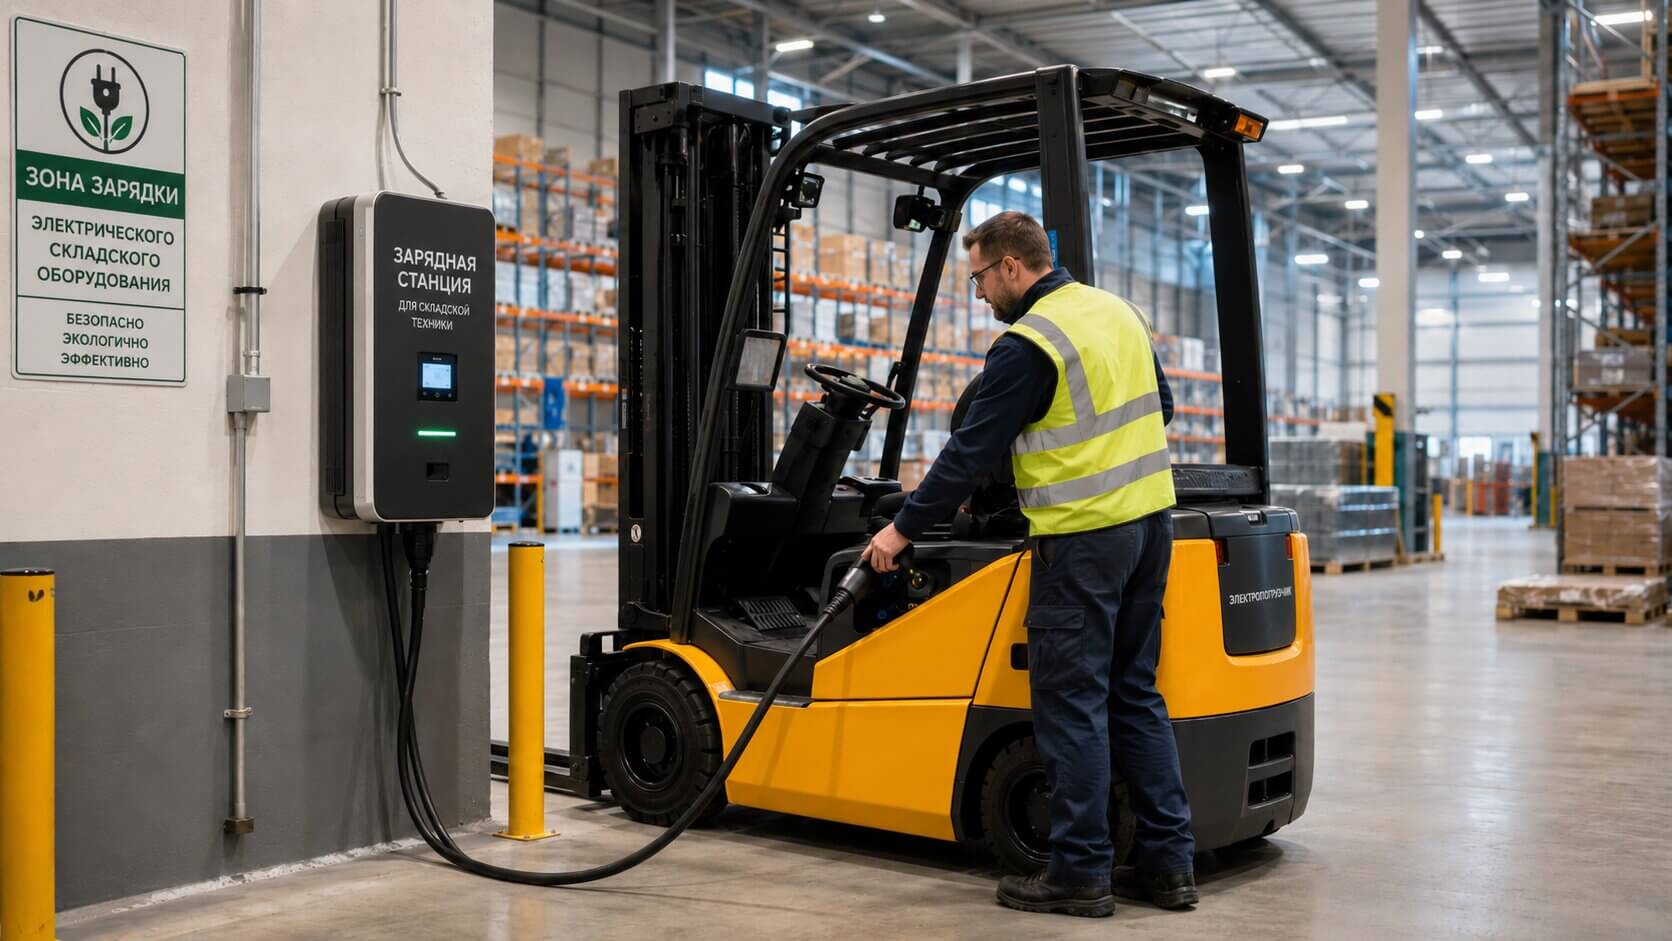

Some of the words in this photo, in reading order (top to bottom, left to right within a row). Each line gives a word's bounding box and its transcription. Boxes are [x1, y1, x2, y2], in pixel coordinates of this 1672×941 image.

[26, 167, 85, 193] ЗОНА
[92, 176, 178, 205] ЗАРЯДКИ
[31, 215, 174, 245] ЭЛЕКТРИЧЕСКОГО
[50, 242, 160, 267] СКЛАДСКОГО
[393, 247, 476, 272] ЗАРЯДНАЯ
[37, 266, 170, 292] ОБОРУДОВАНИЯ
[398, 271, 471, 295] СТАНЦИЯ
[398, 300, 417, 312] ДЛЯ
[418, 303, 470, 316] СКЛАДСКОЙ
[66, 312, 144, 329] БЕЗОПАСНО
[411, 317, 453, 330] ТЕХНИКИ
[63, 333, 149, 350] ЭКОЛОГИЧНО
[61, 352, 150, 369] ЭФФЕКТИВНО
